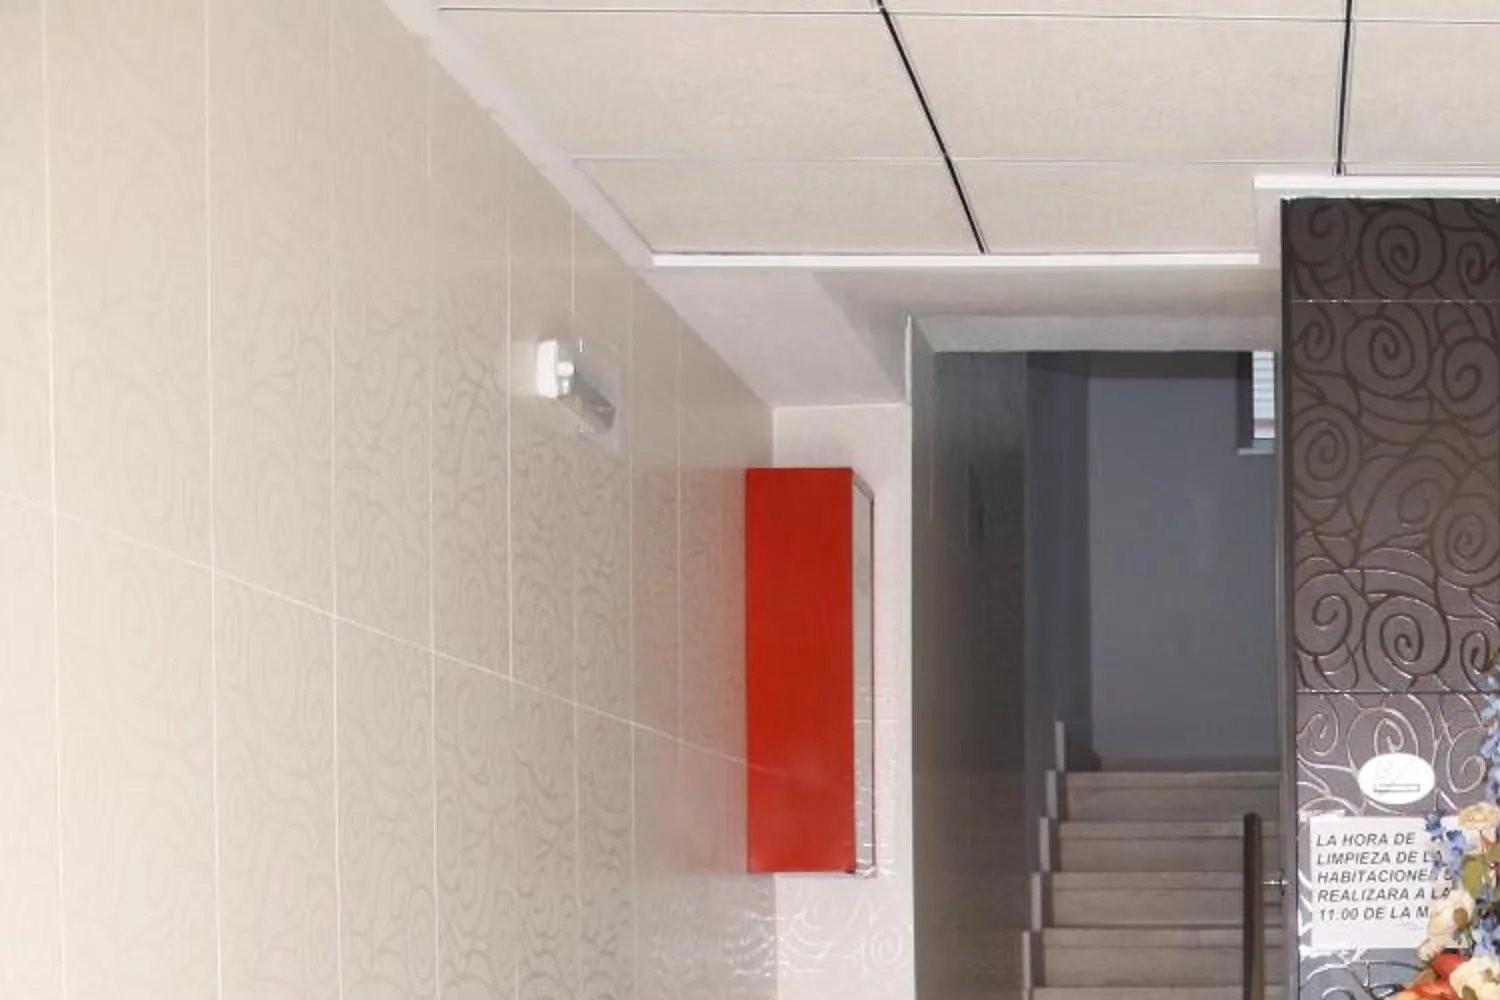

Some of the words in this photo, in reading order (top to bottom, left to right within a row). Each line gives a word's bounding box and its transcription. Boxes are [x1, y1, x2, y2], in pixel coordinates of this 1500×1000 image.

[1316, 834, 1337, 846] LA
[1341, 833, 1388, 846] HORA
[1394, 832, 1416, 845] DE
[1317, 852, 1391, 865] LIMPIEZA
[1396, 852, 1418, 864] DE
[1318, 888, 1409, 902] REALIZARA
[1415, 887, 1425, 900] A
[1363, 907, 1386, 919] DE
[1390, 906, 1410, 919] LA
